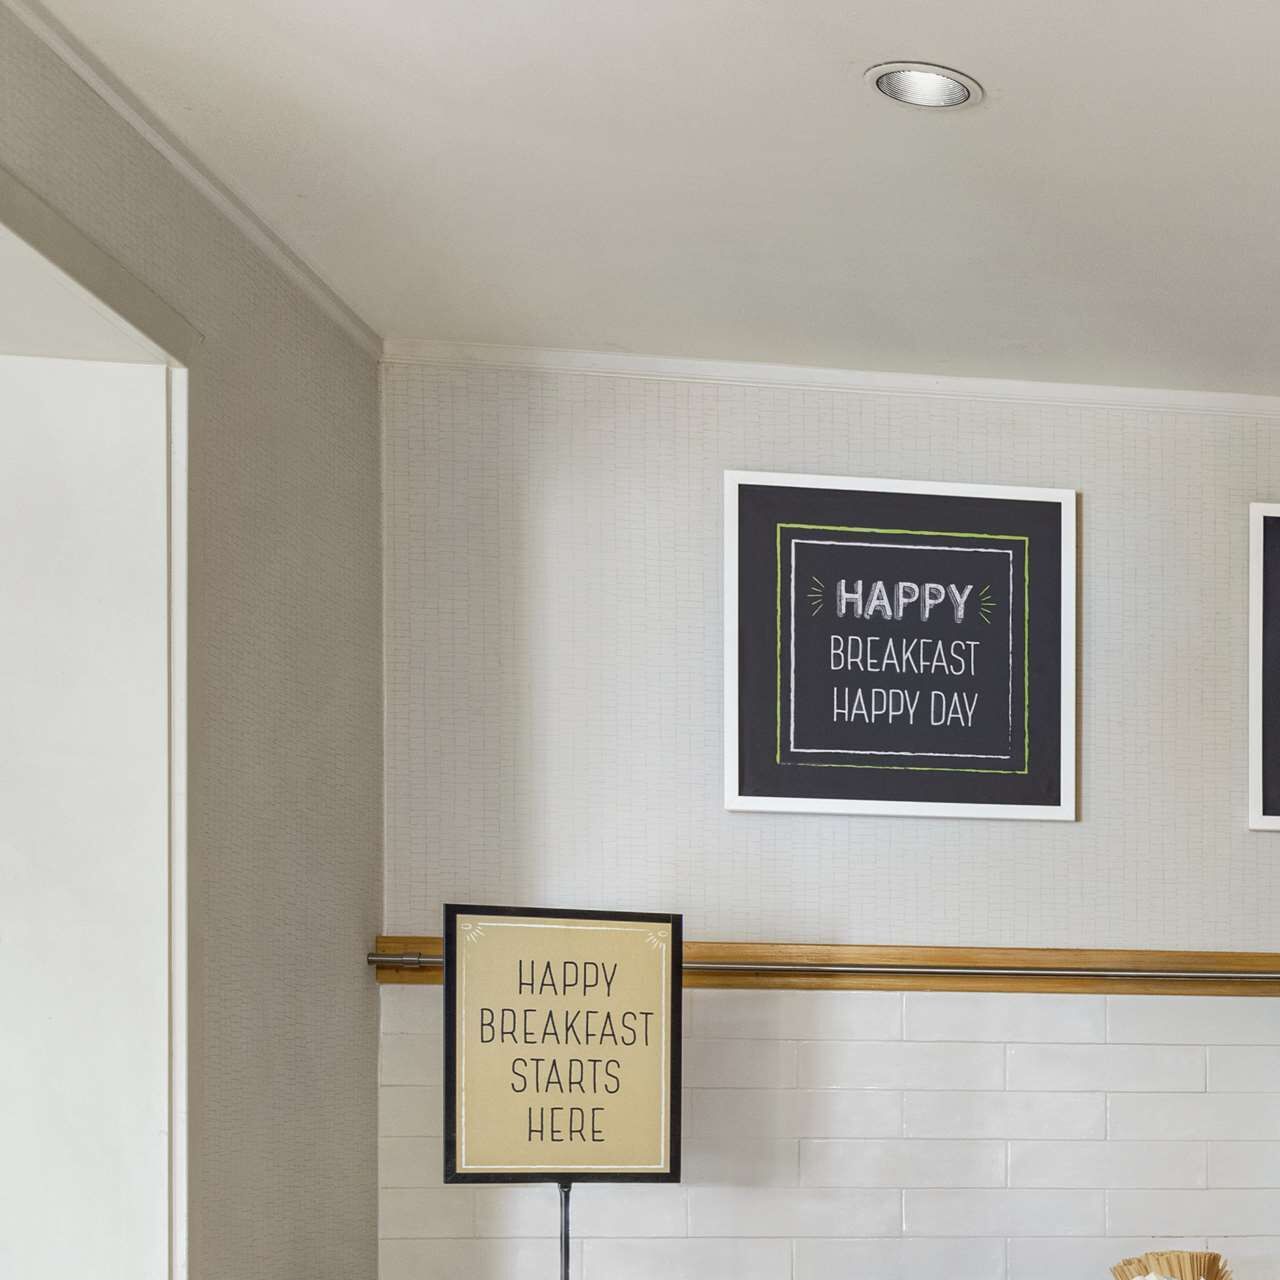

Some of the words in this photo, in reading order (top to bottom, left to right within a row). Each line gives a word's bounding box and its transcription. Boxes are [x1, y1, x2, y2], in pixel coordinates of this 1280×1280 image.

[836, 579, 974, 623] HAPPY
[830, 635, 980, 676] BREAKFAST
[833, 687, 920, 725] HAPPY
[930, 691, 978, 727] DAY
[519, 959, 617, 997] HAPPY
[480, 1008, 654, 1046] BREAKFAST
[511, 1057, 621, 1094] STARTS
[528, 1107, 605, 1142] HERE
